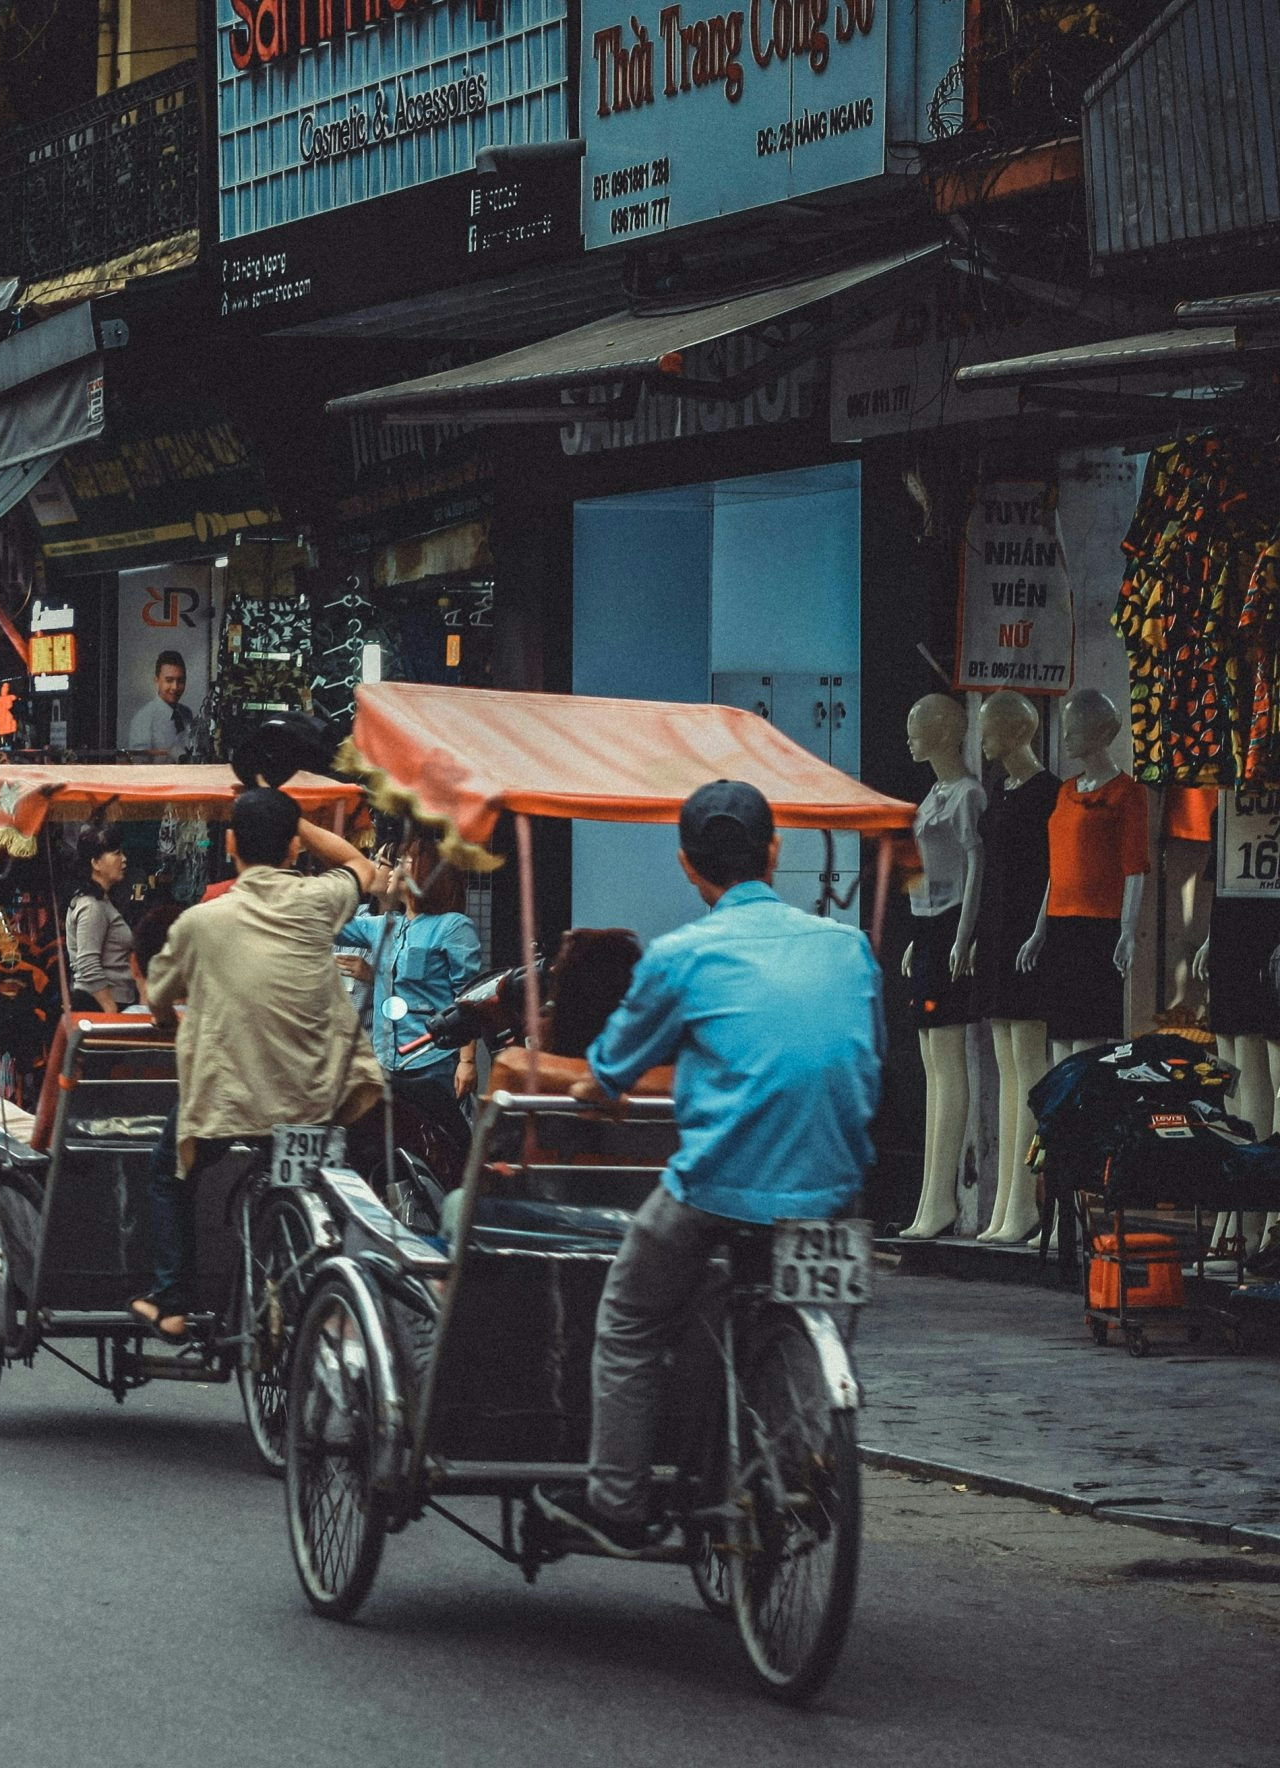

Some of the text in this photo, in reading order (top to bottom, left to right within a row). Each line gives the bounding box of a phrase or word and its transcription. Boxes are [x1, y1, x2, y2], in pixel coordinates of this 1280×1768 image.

[659, 2, 745, 104] Trang
[299, 66, 488, 162] Cosmetic & Accessories
[794, 107, 828, 147] HÀNG
[829, 97, 874, 137] NGANG
[984, 536, 1058, 568] NHÂN
[991, 577, 1049, 609] VIÊN
[998, 618, 1035, 649] NỮ
[991, 661, 1067, 683] 0967.811.777
